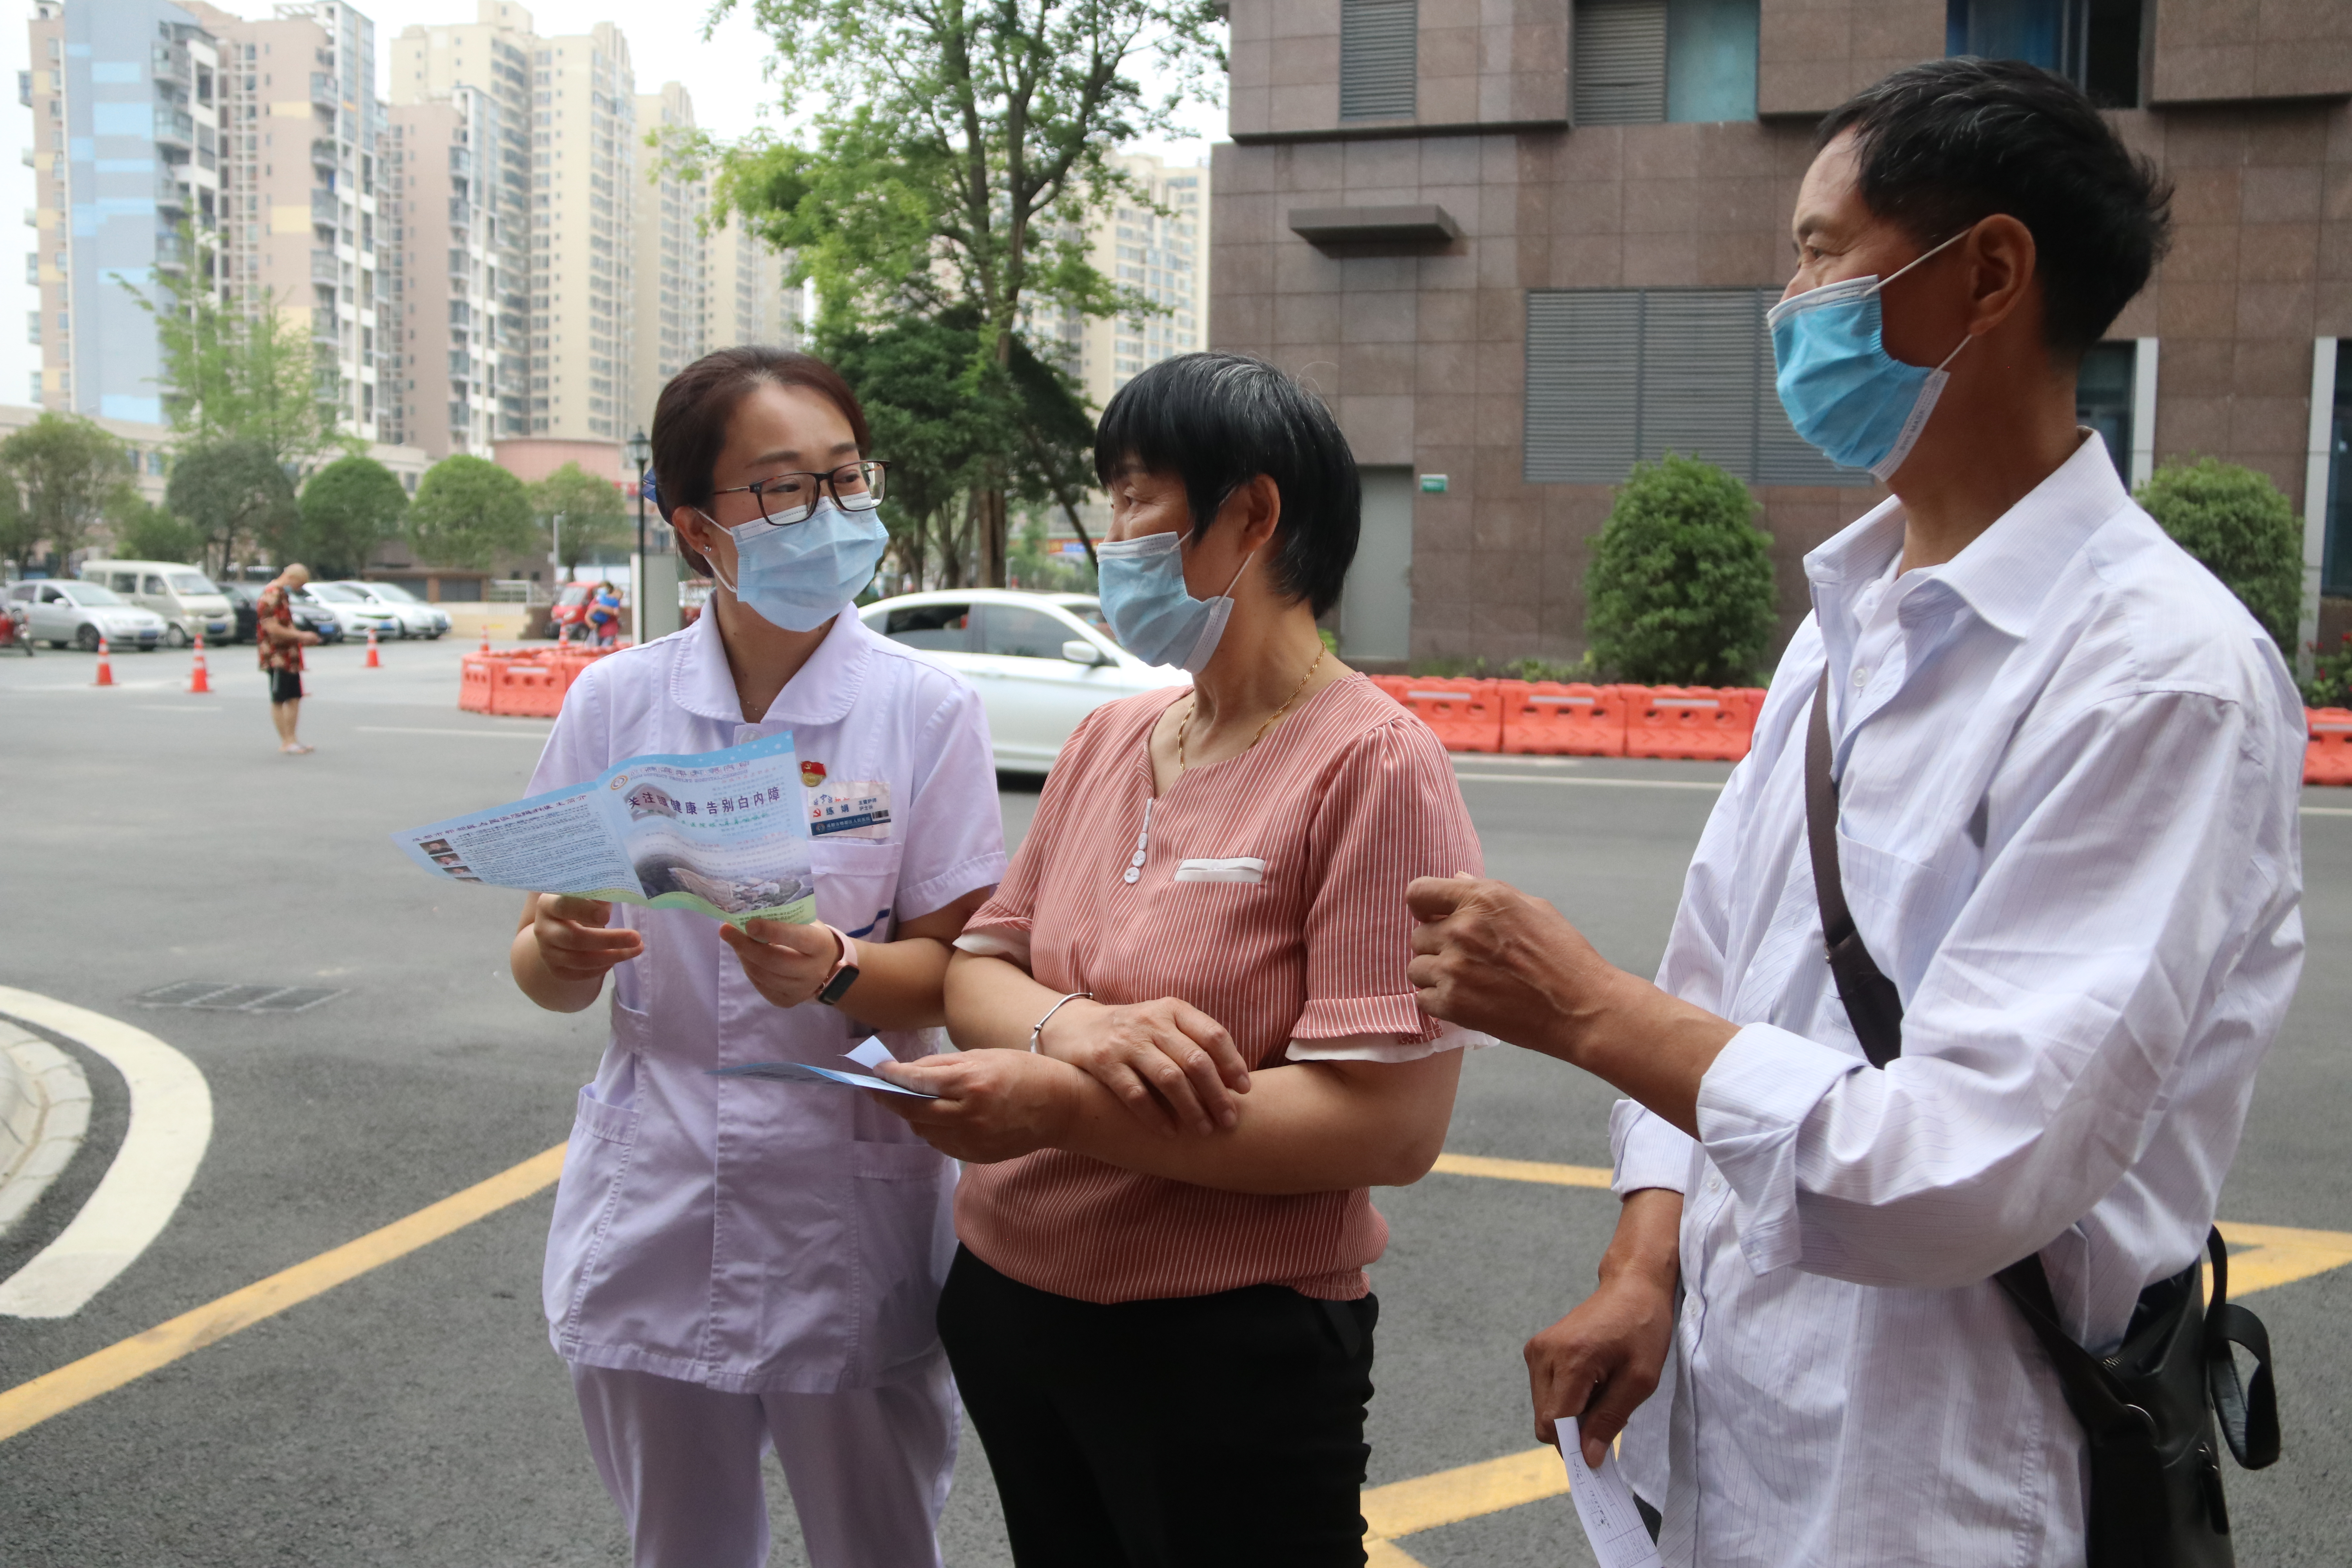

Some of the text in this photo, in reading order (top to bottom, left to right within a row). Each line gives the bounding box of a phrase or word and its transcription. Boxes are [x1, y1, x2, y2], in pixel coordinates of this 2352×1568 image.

[628, 791, 698, 815] 关注眼健康
[706, 786, 780, 815] 告别白内障
